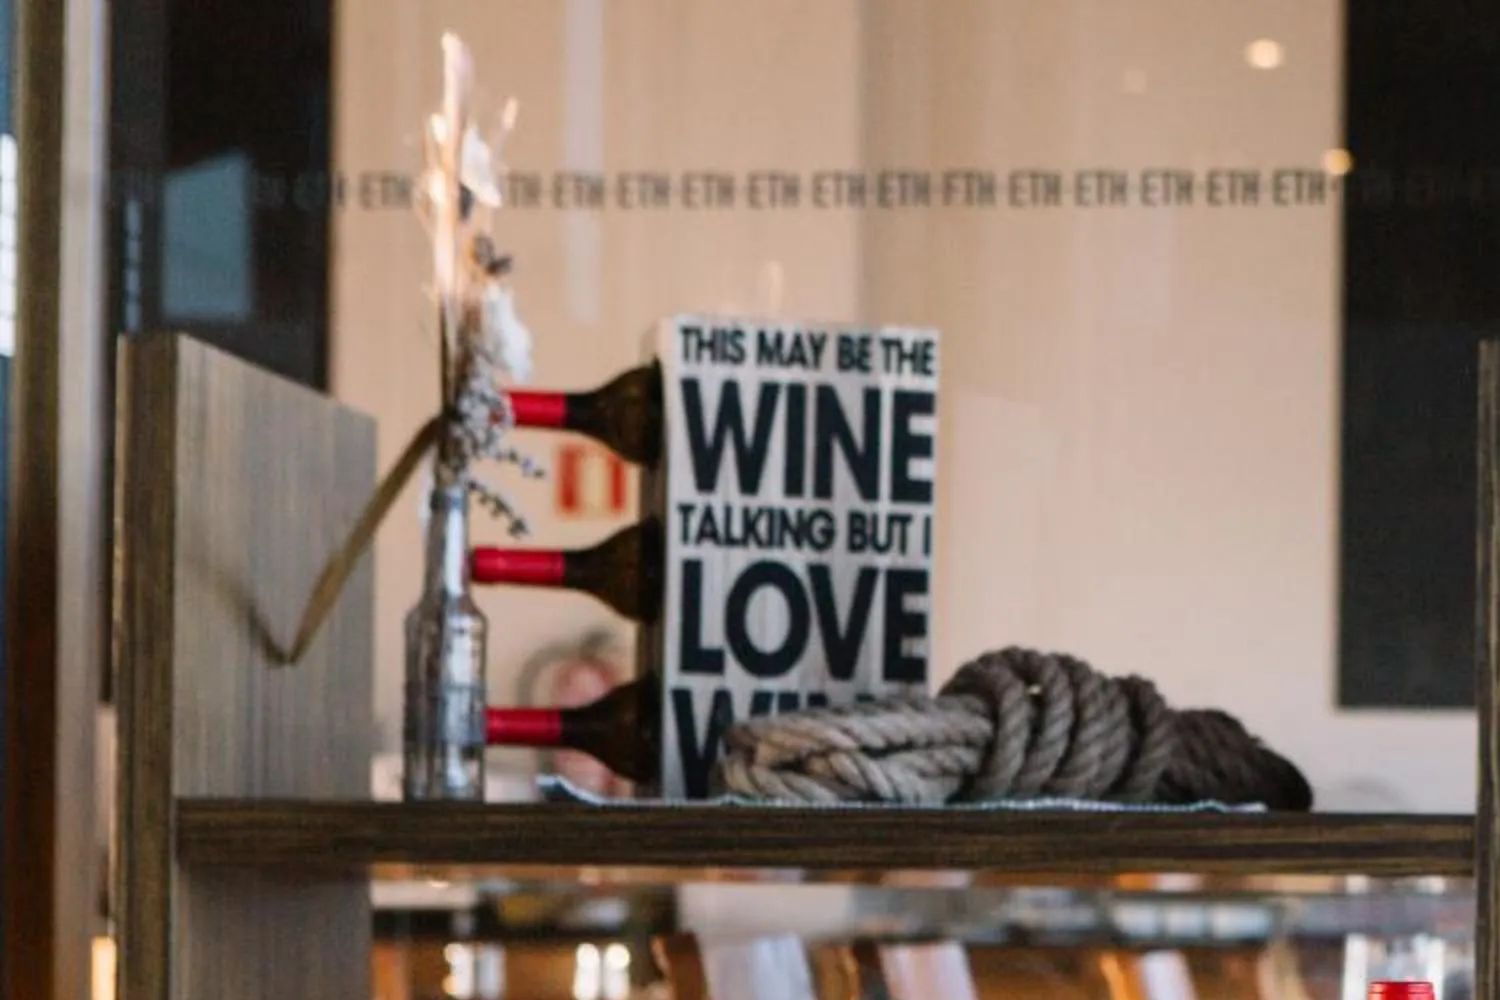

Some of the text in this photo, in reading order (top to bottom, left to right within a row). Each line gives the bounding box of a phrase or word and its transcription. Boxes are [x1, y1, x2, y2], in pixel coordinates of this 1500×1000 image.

[681, 326, 935, 375] THIS MAY BE THE
[680, 378, 937, 505] WINE
[677, 504, 932, 557] TALKING BUT I
[678, 559, 931, 684] LOVE
